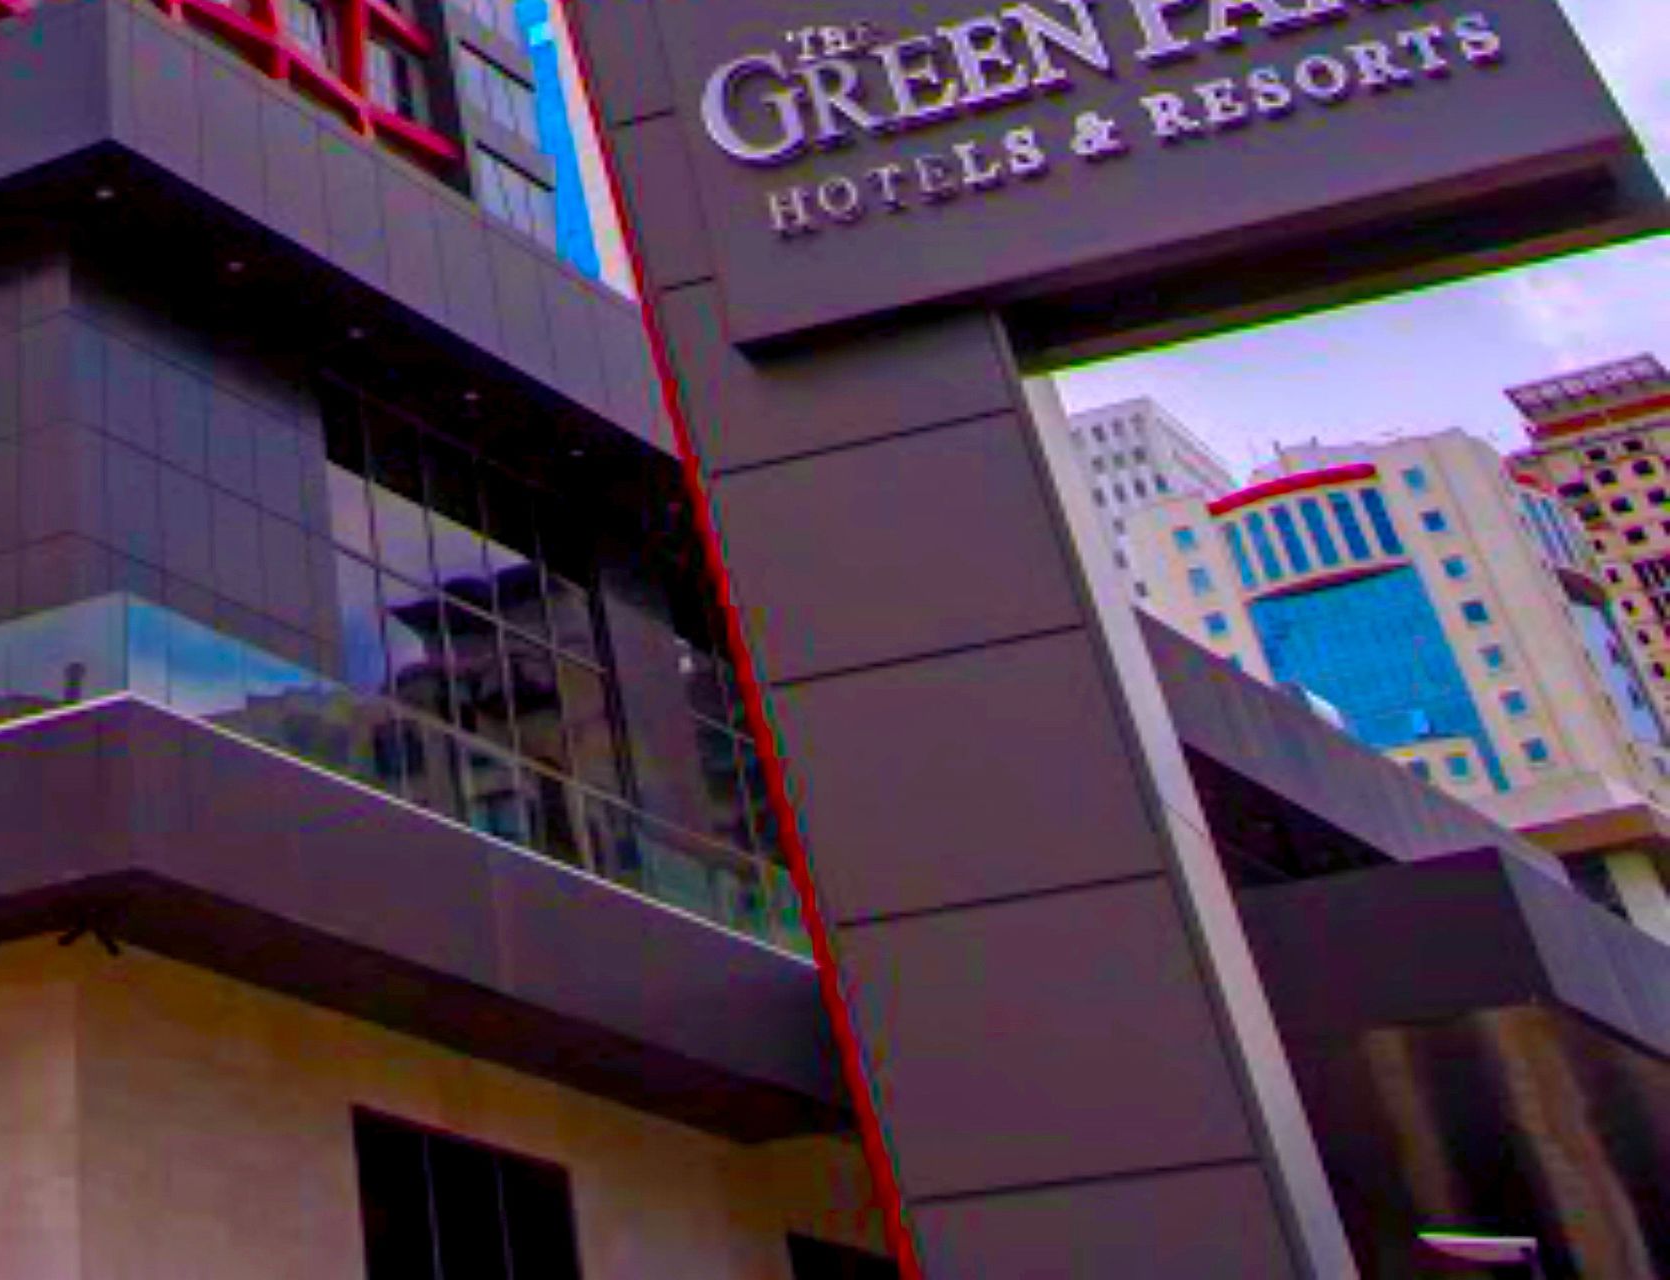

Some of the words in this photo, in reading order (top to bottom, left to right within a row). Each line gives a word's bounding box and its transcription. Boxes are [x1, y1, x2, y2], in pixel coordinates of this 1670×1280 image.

[766, 124, 1046, 235] HOTELS
[1071, 111, 1124, 156] &
[1139, 11, 1502, 140] RESORTS
